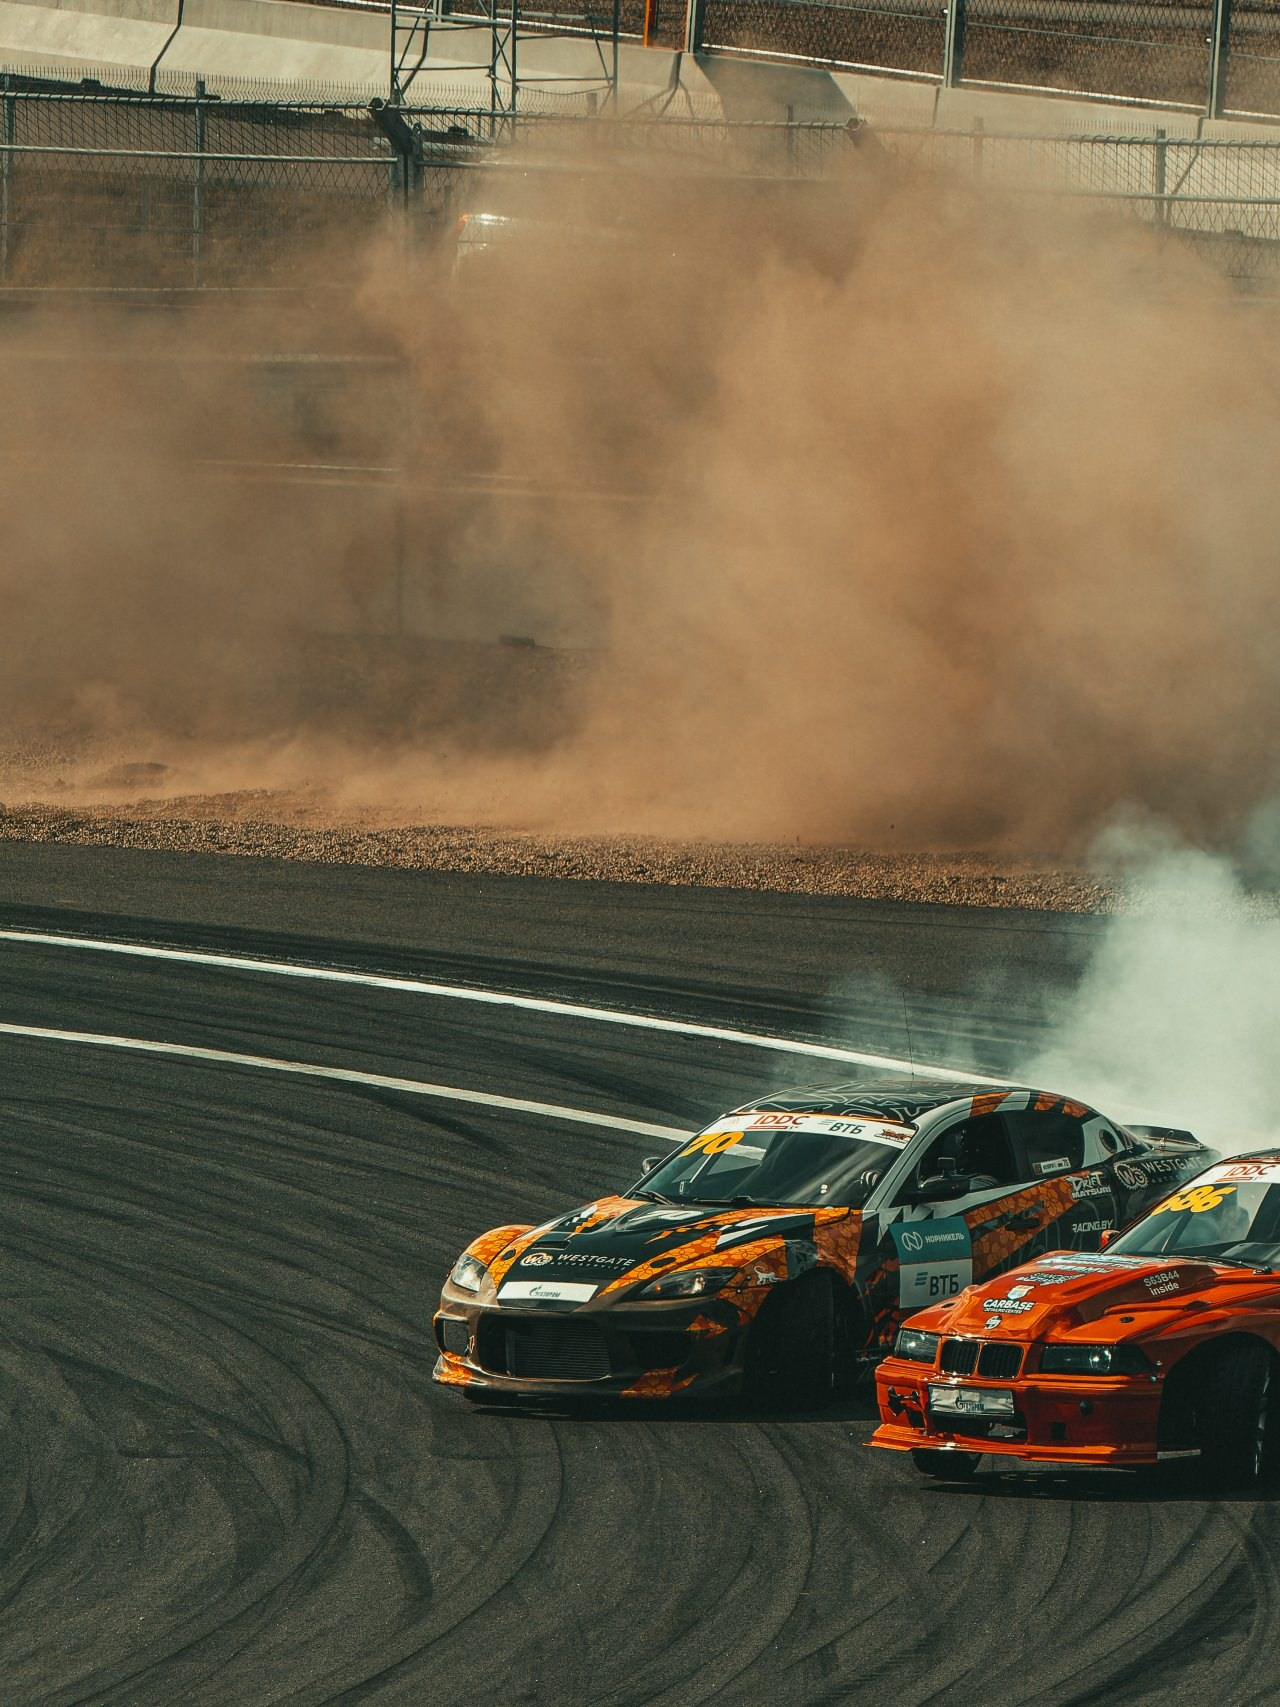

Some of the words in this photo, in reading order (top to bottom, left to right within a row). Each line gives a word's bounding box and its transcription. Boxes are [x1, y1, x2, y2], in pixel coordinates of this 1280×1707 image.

[753, 1115, 810, 1125] IDDC
[829, 1122, 866, 1135] ВТБ
[679, 1131, 745, 1158] 70
[1141, 1157, 1202, 1174] WESTGATE
[1224, 1165, 1276, 1176] IDDC
[1072, 1186, 1111, 1199] MATSURI
[1150, 1185, 1238, 1216] 686
[925, 1232, 965, 1244] НОРНИКЕЛЬ
[557, 1254, 635, 1266] WESTGATE
[929, 1274, 959, 1296] ВТБ
[1144, 1270, 1180, 1287] S63B44
[1149, 1281, 1180, 1296] inside
[983, 1299, 1035, 1311] CARBASE
